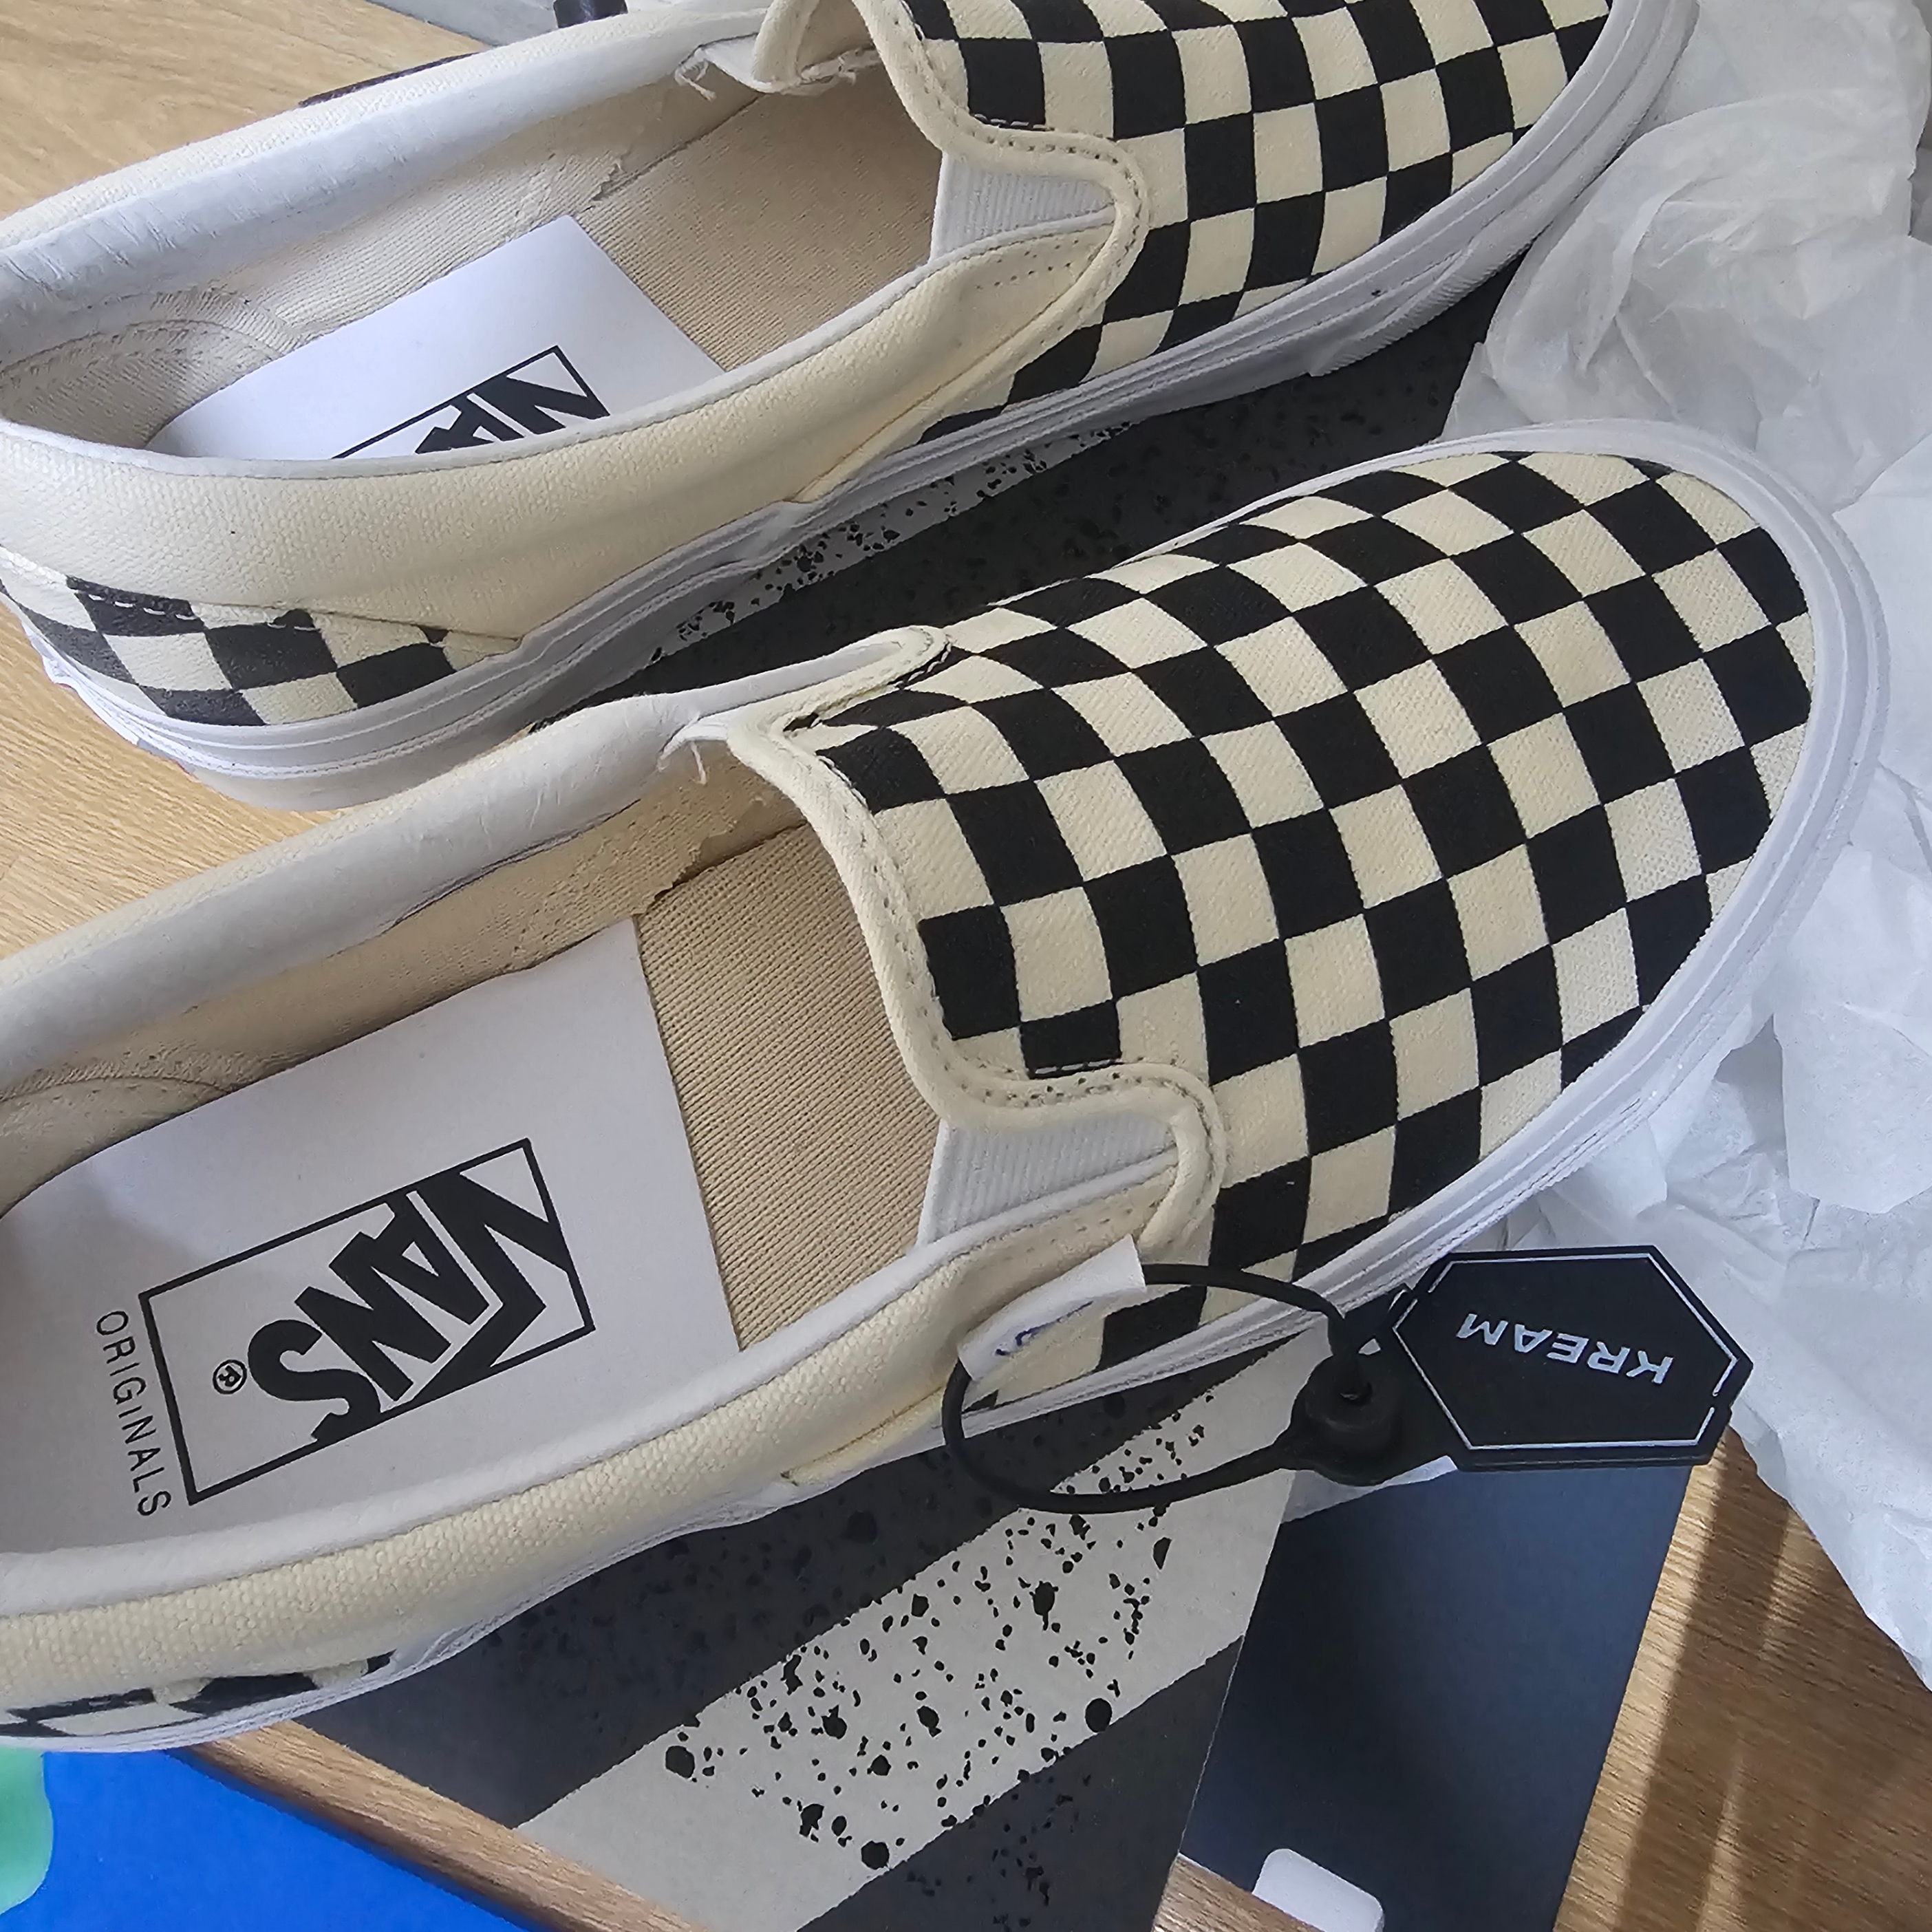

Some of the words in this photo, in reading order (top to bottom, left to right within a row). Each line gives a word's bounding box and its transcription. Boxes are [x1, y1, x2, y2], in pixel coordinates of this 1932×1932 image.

[415, 372, 611, 454] VA
[247, 1171, 571, 1442] VANS
[1455, 1312, 1675, 1385] KREAM
[96, 1309, 172, 1517] ORIGINALS
